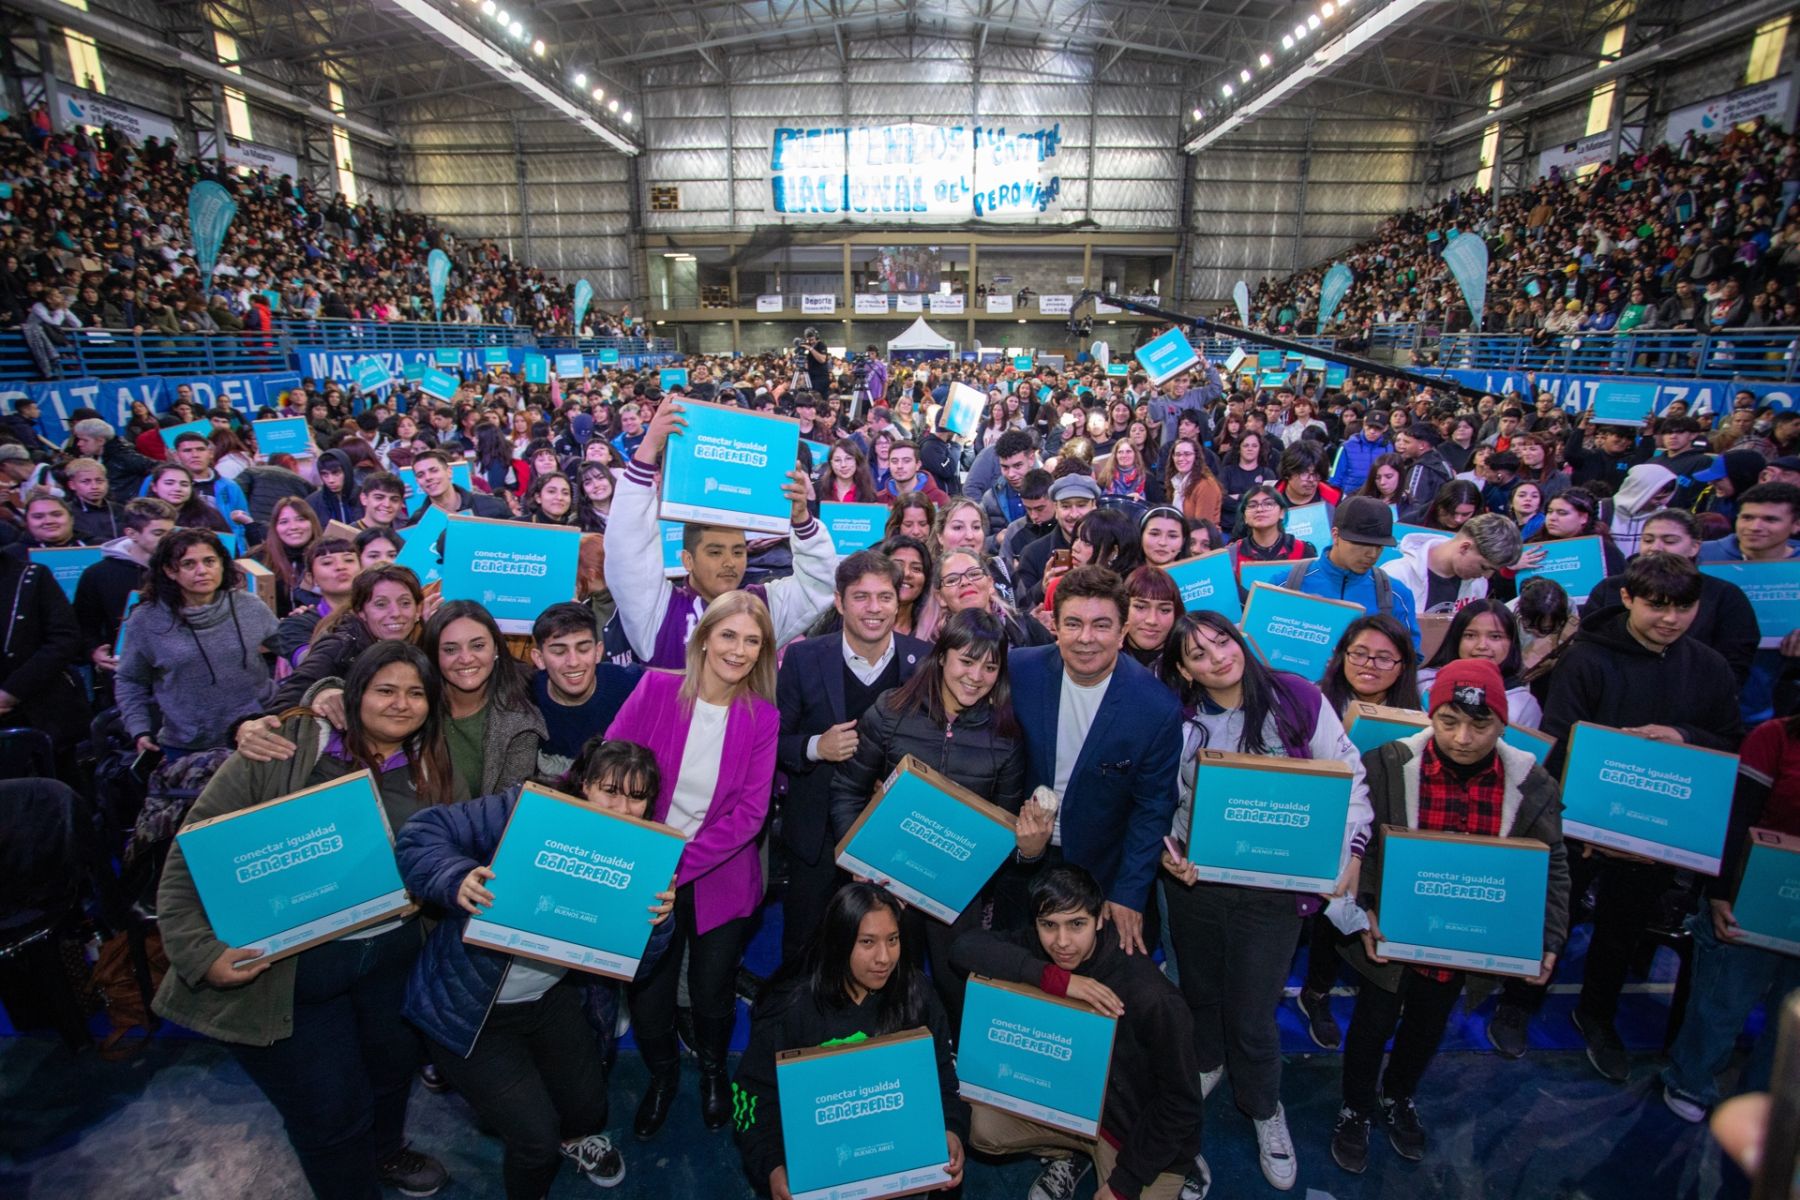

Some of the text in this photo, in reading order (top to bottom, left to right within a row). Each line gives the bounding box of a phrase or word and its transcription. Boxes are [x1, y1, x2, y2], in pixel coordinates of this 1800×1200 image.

[973, 176, 1059, 217] PERONISMO
[190, 380, 265, 414] DEL
[1540, 379, 1713, 417] MATZA
[698, 435, 767, 452] conectar igualdad
[475, 550, 546, 562] conectar igualdad
[1604, 759, 1692, 784] conectar igualdad
[1228, 798, 1310, 812] conectar igualdad
[234, 822, 336, 864] conectar igualdad
[912, 810, 976, 849] conectar igualdad
[545, 839, 635, 870] conectar igualdad
[1417, 870, 1505, 886] conectar igualdad
[992, 1018, 1072, 1045] conectar igualdad
[815, 1077, 900, 1104] conectar igualdad
